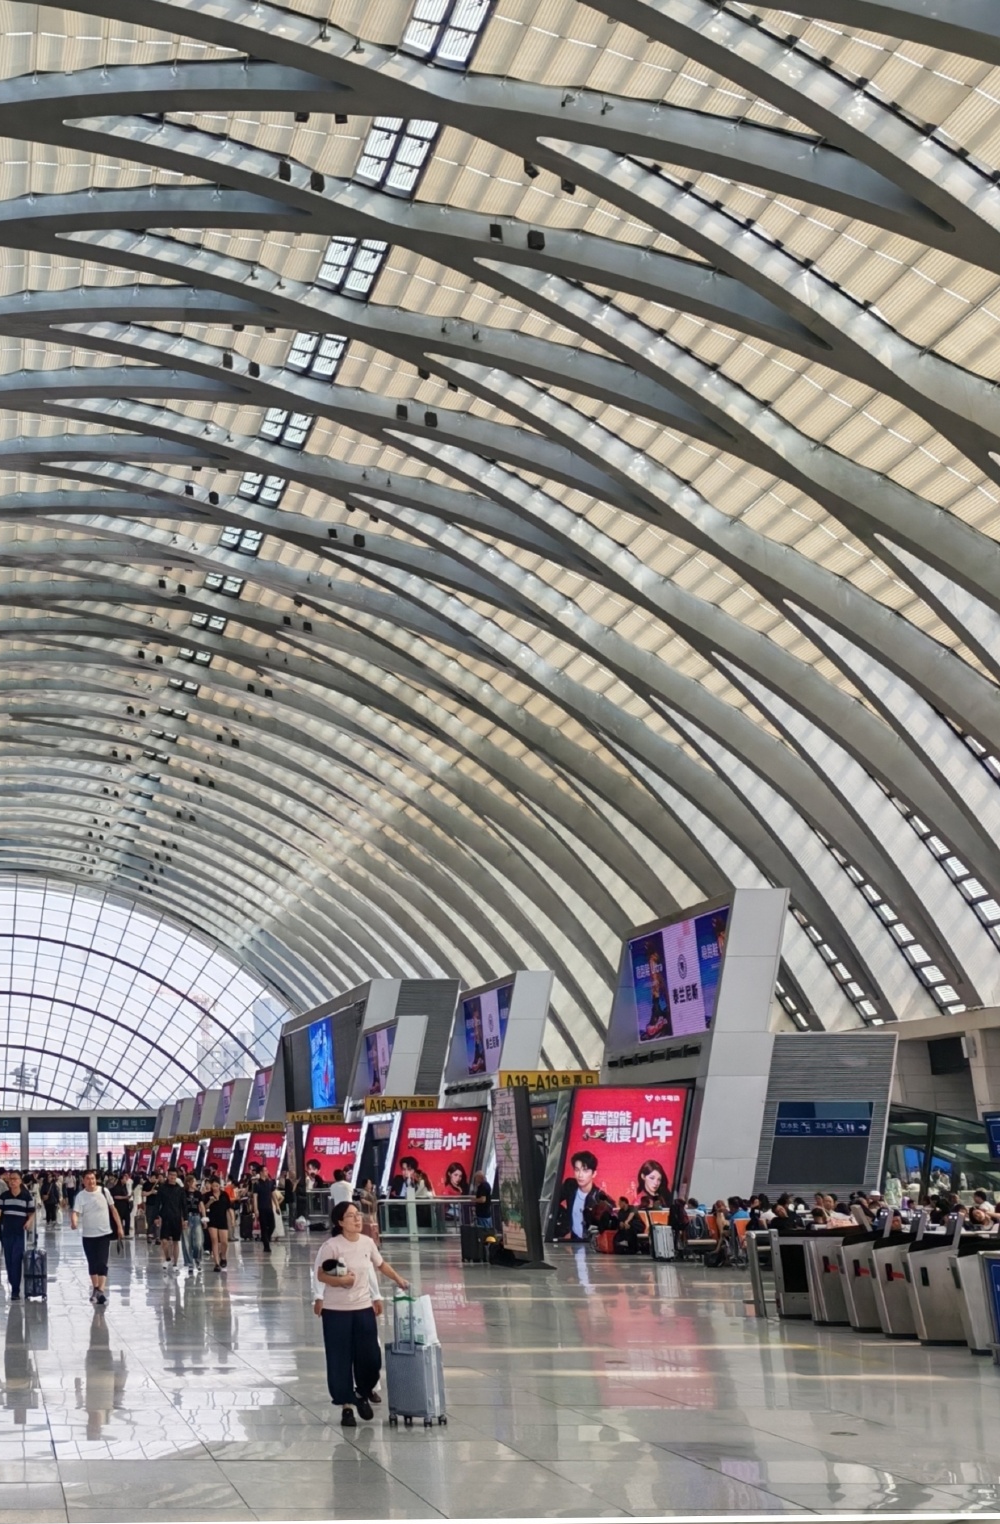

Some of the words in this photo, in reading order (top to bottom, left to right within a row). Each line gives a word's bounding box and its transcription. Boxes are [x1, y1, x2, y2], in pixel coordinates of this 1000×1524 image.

[562, 1075, 593, 1084] 检票口
[369, 1100, 408, 1112] A16-A17
[581, 1111, 632, 1126] 高端智能
[606, 1128, 631, 1143] 就要
[632, 1117, 673, 1143] 小牛
[442, 1132, 471, 1150] 小牛
